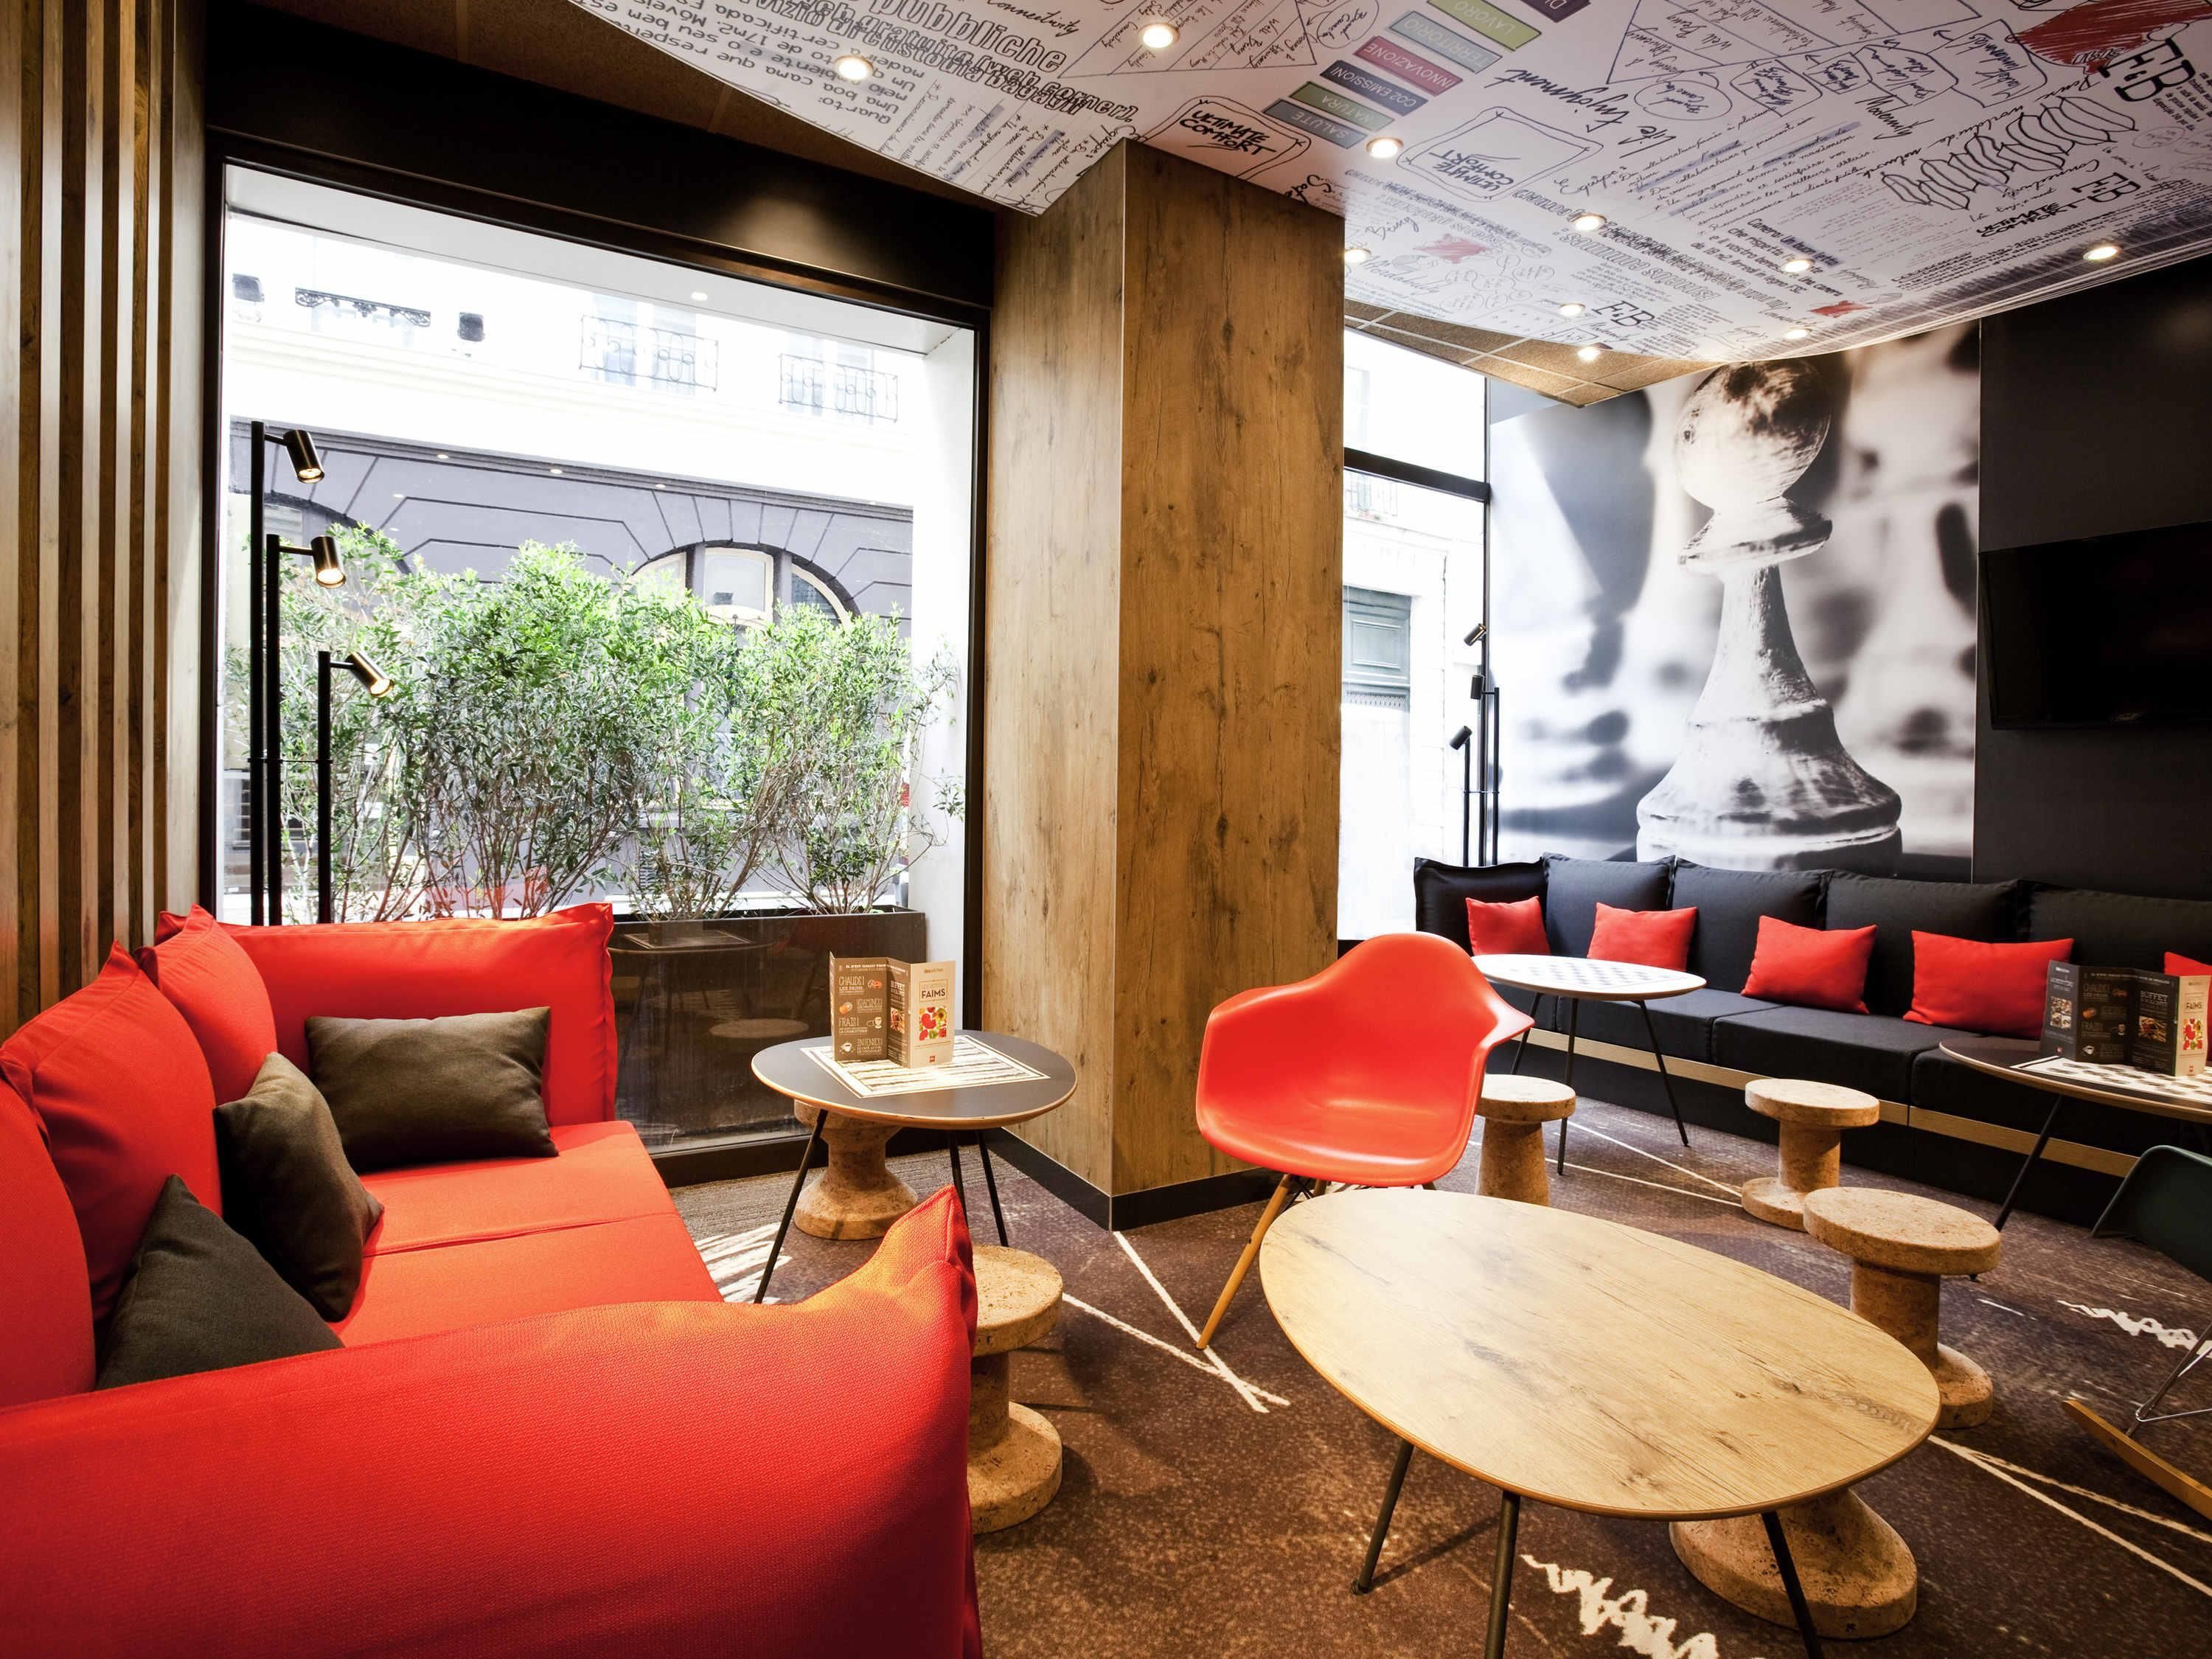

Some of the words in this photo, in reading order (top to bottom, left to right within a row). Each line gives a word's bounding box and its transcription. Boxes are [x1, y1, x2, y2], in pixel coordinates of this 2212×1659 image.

[627, 9, 669, 30] bem
[715, 4, 840, 50] certificada
[987, 0, 1081, 37] onnectivity
[1454, 0, 1517, 37] LAVORO
[678, 25, 718, 44] seu
[728, 41, 741, 50] o
[1402, 16, 1490, 69] TERRITORIO
[716, 52, 756, 69] que
[750, 48, 763, 58] e
[777, 41, 802, 57] de
[765, 66, 813, 86] cama
[1363, 42, 1455, 89] INNOVAZIONE
[823, 83, 857, 101] boa
[868, 84, 908, 101] meio
[891, 77, 915, 92] Um
[1329, 66, 1392, 99] EMISSIONI
[818, 96, 891, 124] Quarto:
[866, 96, 899, 115] Uma
[1321, 94, 1374, 124] NATURA
[1391, 89, 1417, 108] CO2
[1179, 118, 1278, 156] COMFORT
[1191, 110, 1271, 143] ULTIMATE
[1290, 109, 1351, 139] SALUTE
[1427, 149, 1514, 187] COMFORT
[1430, 162, 1502, 192] ULTIMATE
[2001, 159, 2099, 198] Connectivity
[1364, 215, 1420, 242] Being
[1976, 202, 2058, 234] ULTIMATE
[1980, 197, 2088, 237] COMFORT
[1728, 227, 1749, 237] che
[921, 988, 946, 999] FAIMS
